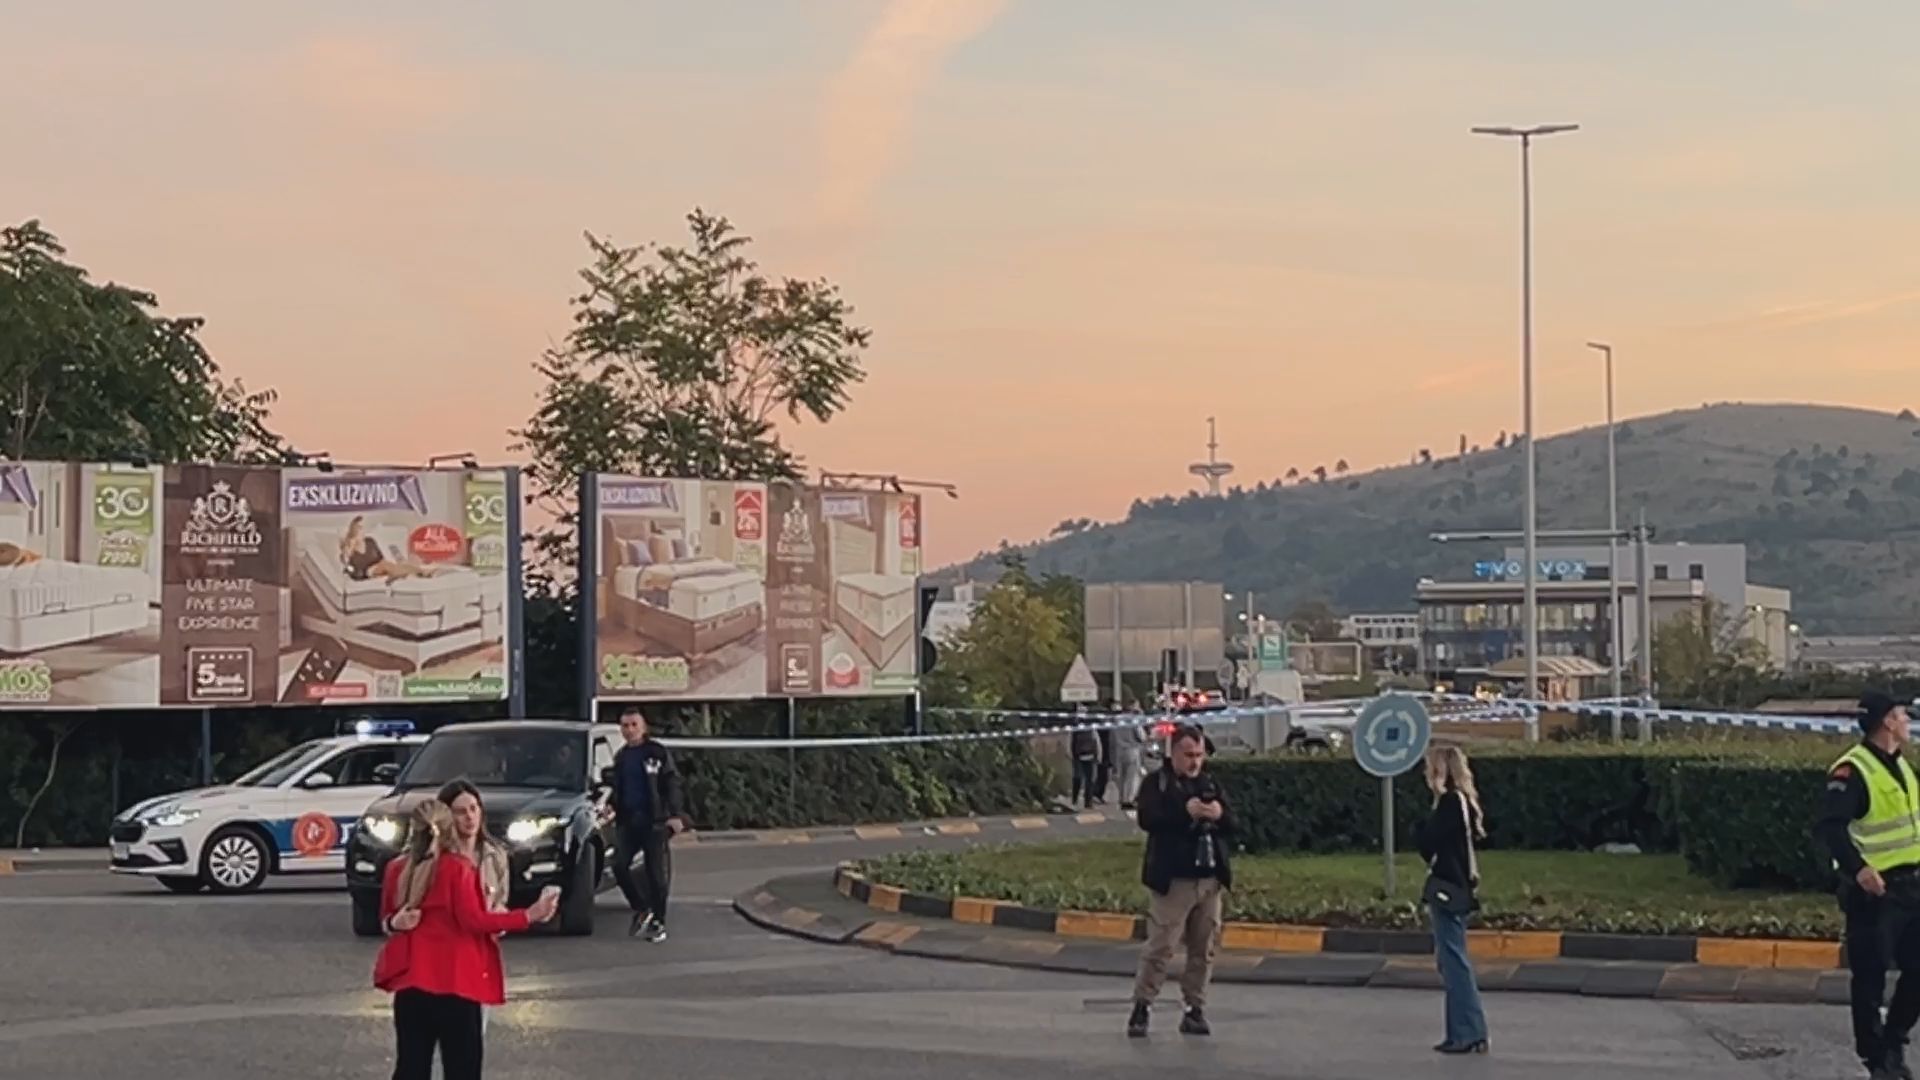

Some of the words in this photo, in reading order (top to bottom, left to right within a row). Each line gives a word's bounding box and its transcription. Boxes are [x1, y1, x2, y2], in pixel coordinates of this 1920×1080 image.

[289, 483, 398, 507] EKSKLUZIVNO
[181, 531, 262, 546] RICHFIELD
[186, 578, 253, 592] ULTIMATE
[185, 597, 215, 611] FIVE
[219, 597, 255, 611] STAR
[197, 662, 216, 685] 5
